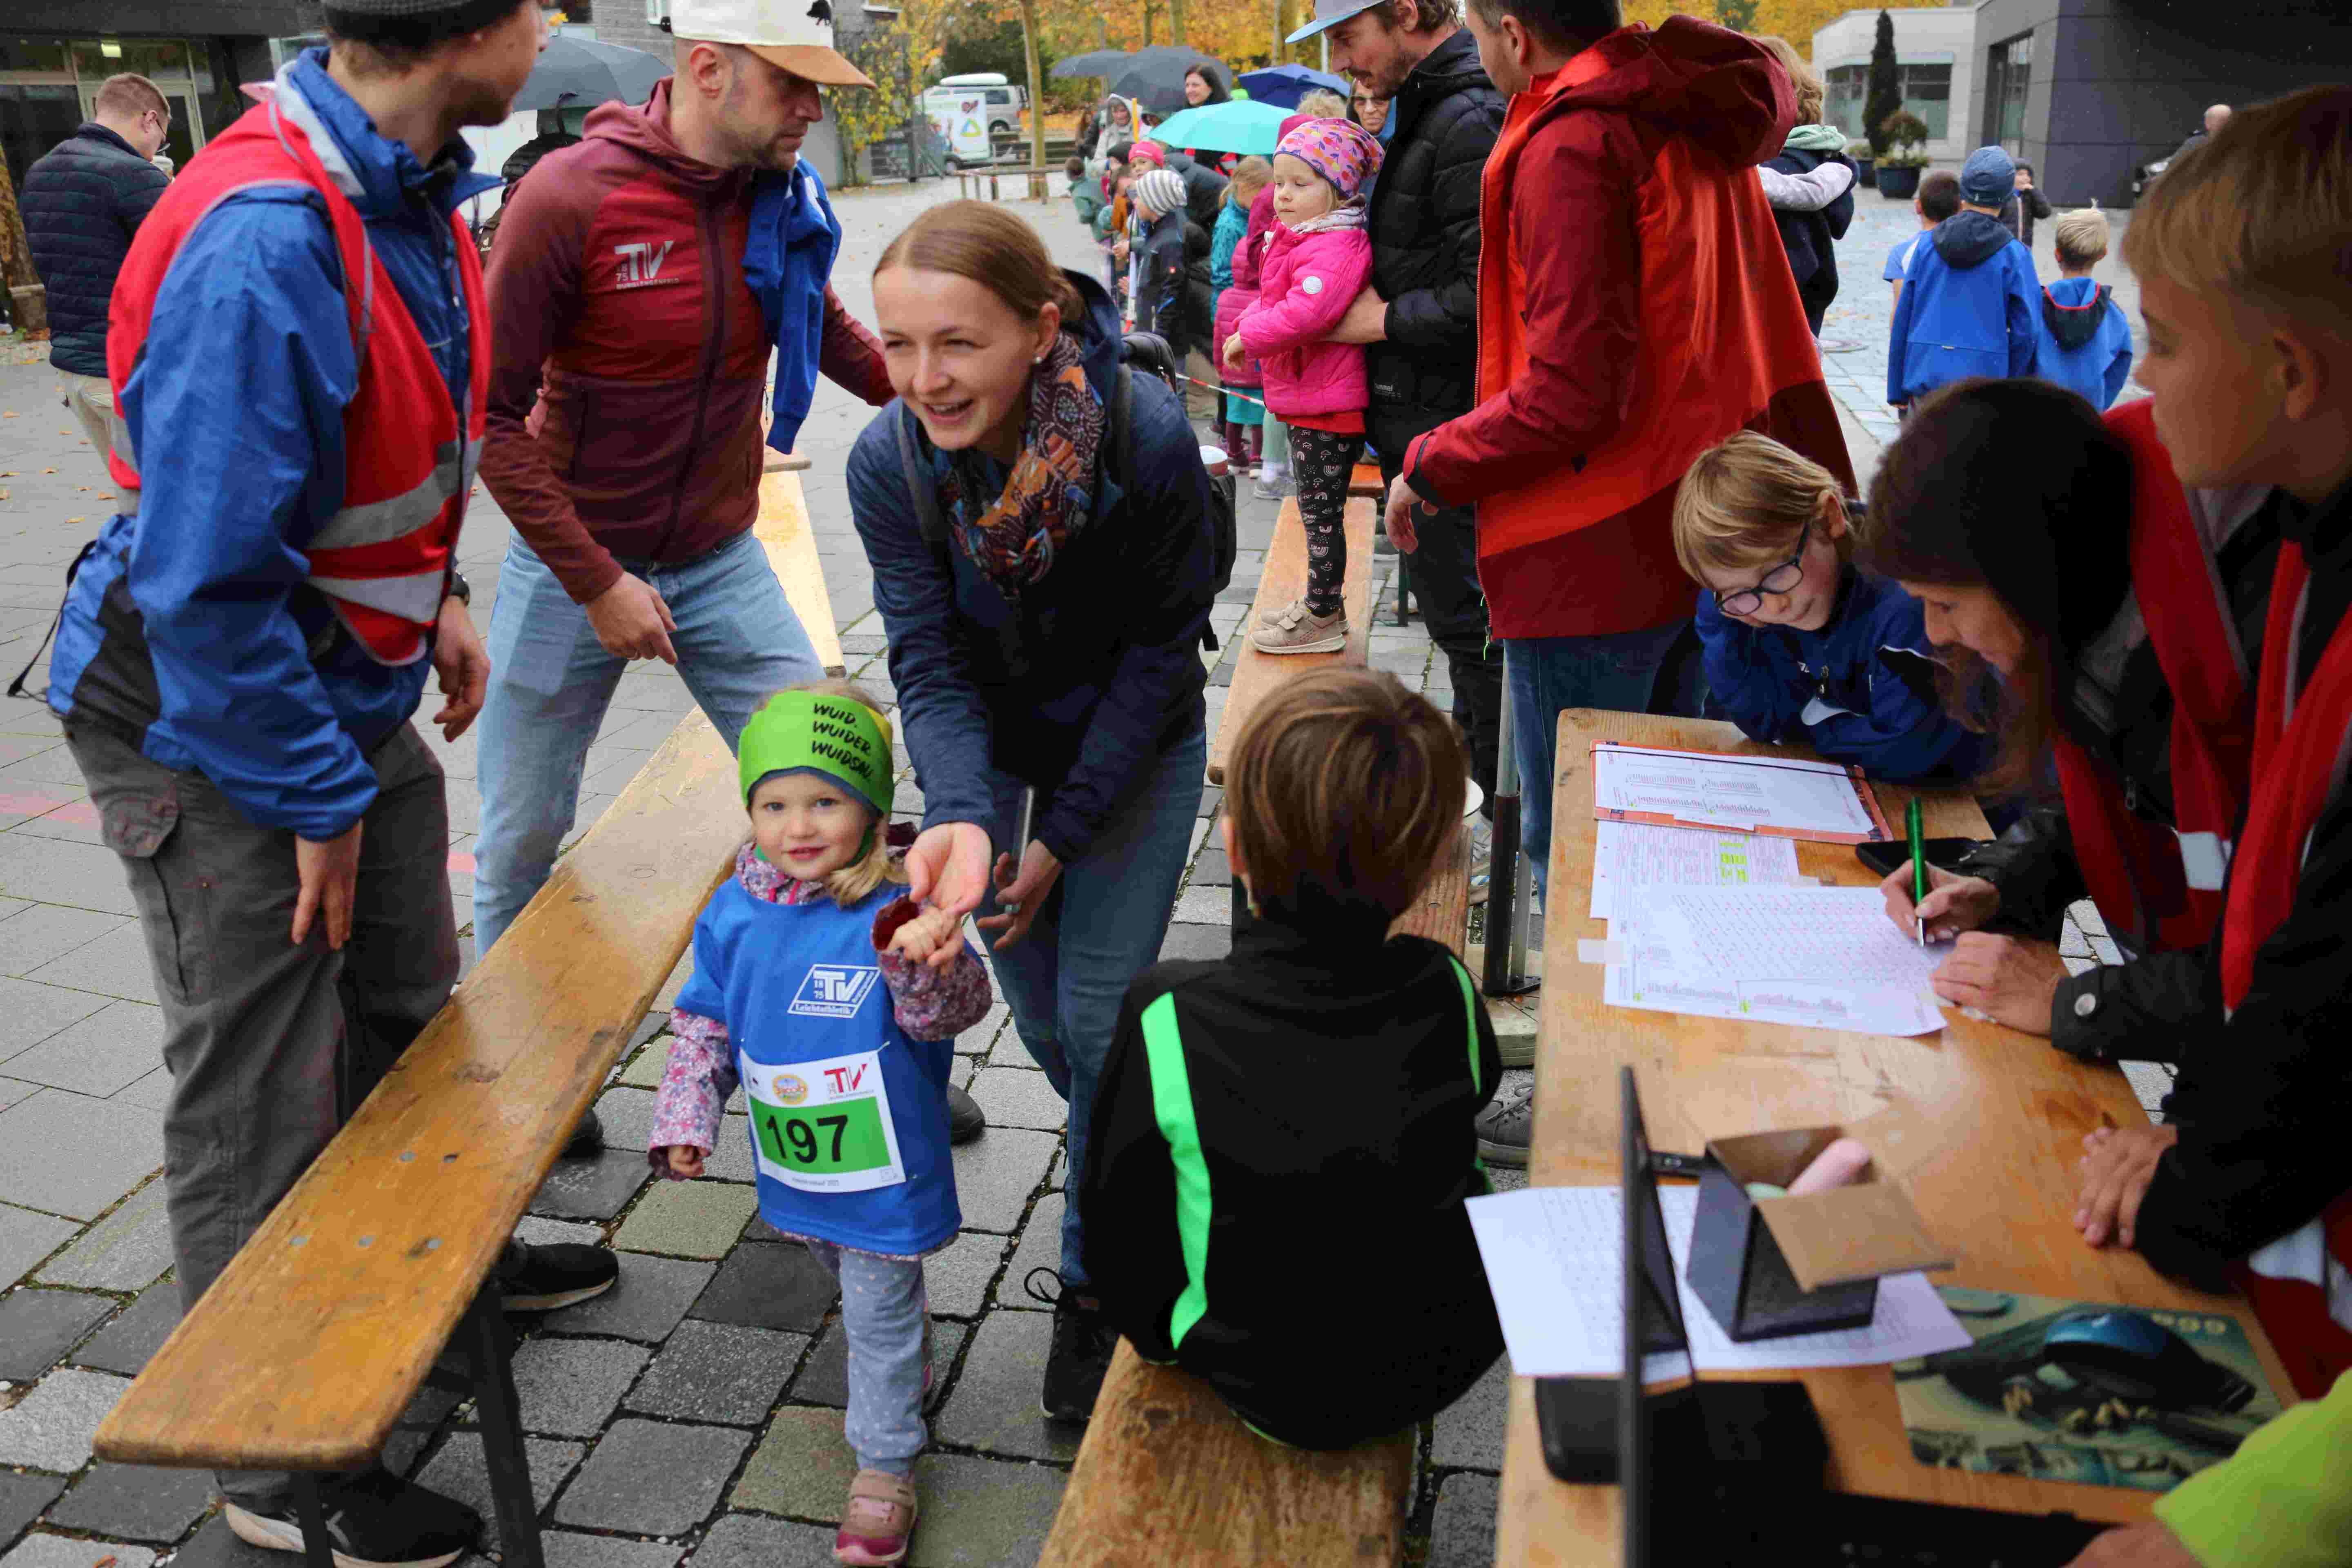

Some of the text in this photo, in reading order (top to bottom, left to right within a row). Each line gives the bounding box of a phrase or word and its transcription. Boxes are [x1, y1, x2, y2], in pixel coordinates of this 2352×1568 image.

[614, 240, 675, 281] TV
[615, 273, 628, 282] 75
[813, 703, 857, 728] WUID.
[813, 969, 867, 1002] TV
[795, 1003, 851, 1015] Leichtathletik
[823, 1063, 868, 1093] TV
[766, 1114, 848, 1164] 197
